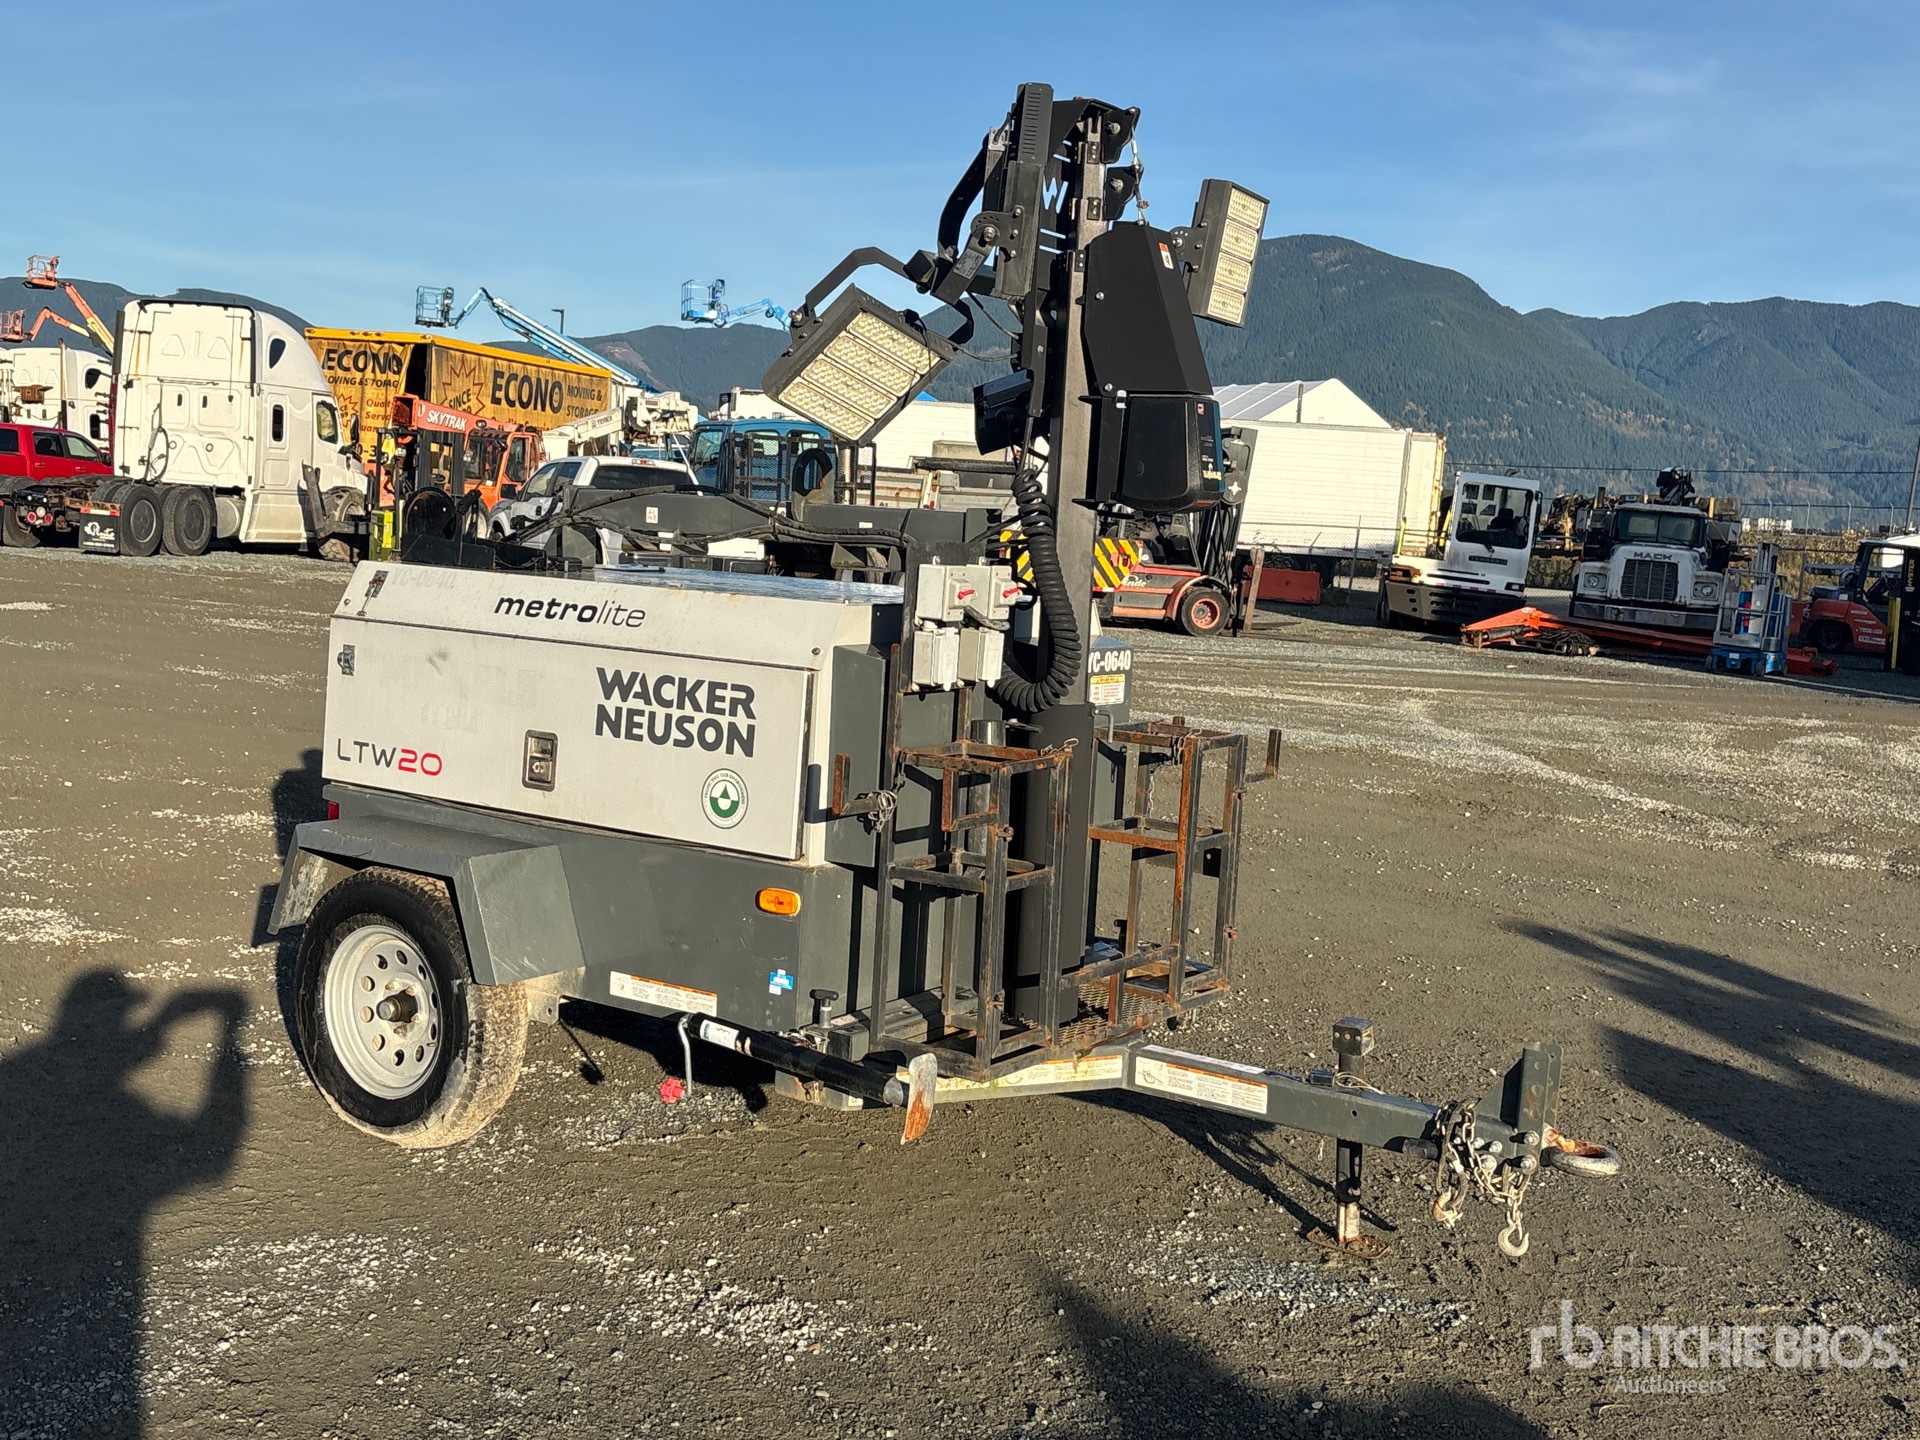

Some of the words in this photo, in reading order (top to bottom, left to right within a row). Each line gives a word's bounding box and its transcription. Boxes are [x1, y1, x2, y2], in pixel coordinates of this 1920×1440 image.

[321, 348, 403, 375] ECONO
[325, 375, 356, 385] OVING
[490, 370, 563, 414] ECONO
[567, 385, 595, 400] MOVING
[596, 389, 602, 401] &
[448, 388, 471, 410] SINCE
[427, 409, 468, 431] SKYTRAK
[1634, 551, 1672, 560] MACK
[1907, 559, 1915, 587] HYSTER
[494, 597, 646, 628] metrolite
[596, 666, 757, 720] WACKER
[595, 703, 756, 758] NEUSON
[337, 738, 442, 777] LTW20
